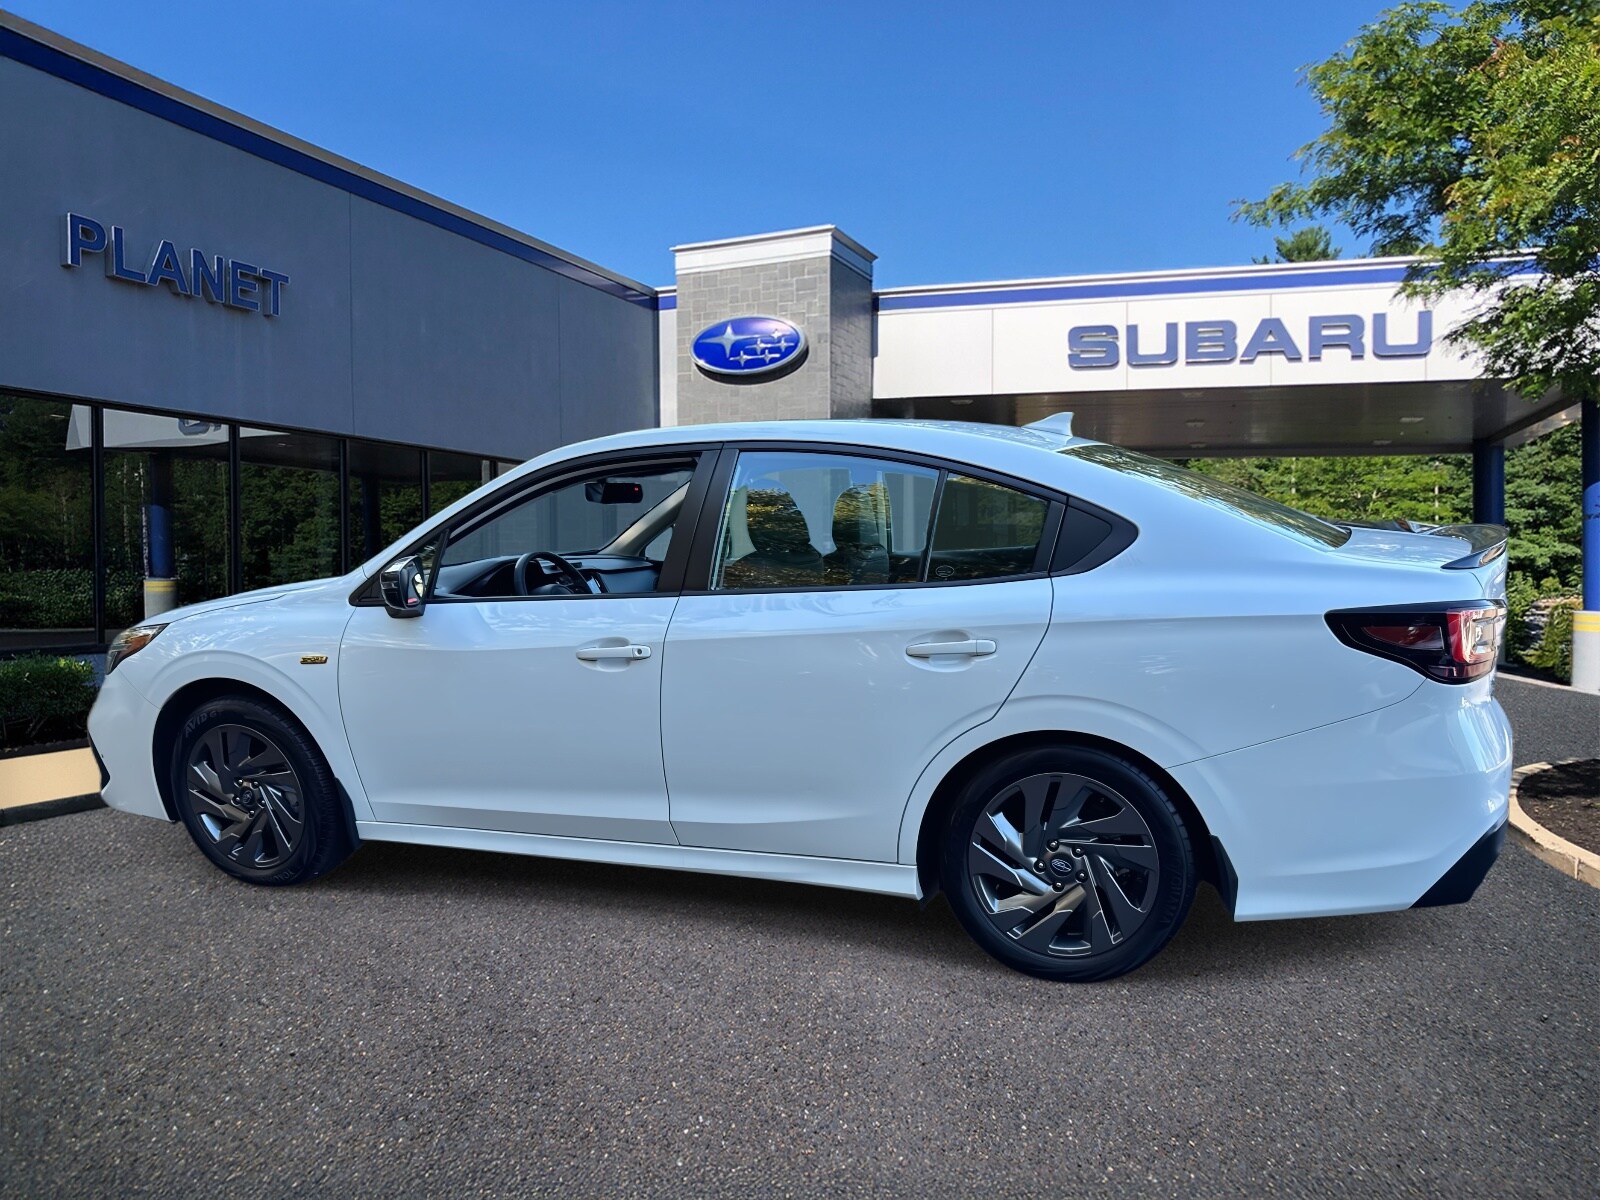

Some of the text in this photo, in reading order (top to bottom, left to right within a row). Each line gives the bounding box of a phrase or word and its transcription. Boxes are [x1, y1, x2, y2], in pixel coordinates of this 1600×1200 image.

[67, 212, 290, 317] PLANET
[1067, 310, 1433, 368] SUBARU
[184, 712, 208, 738] AVID
